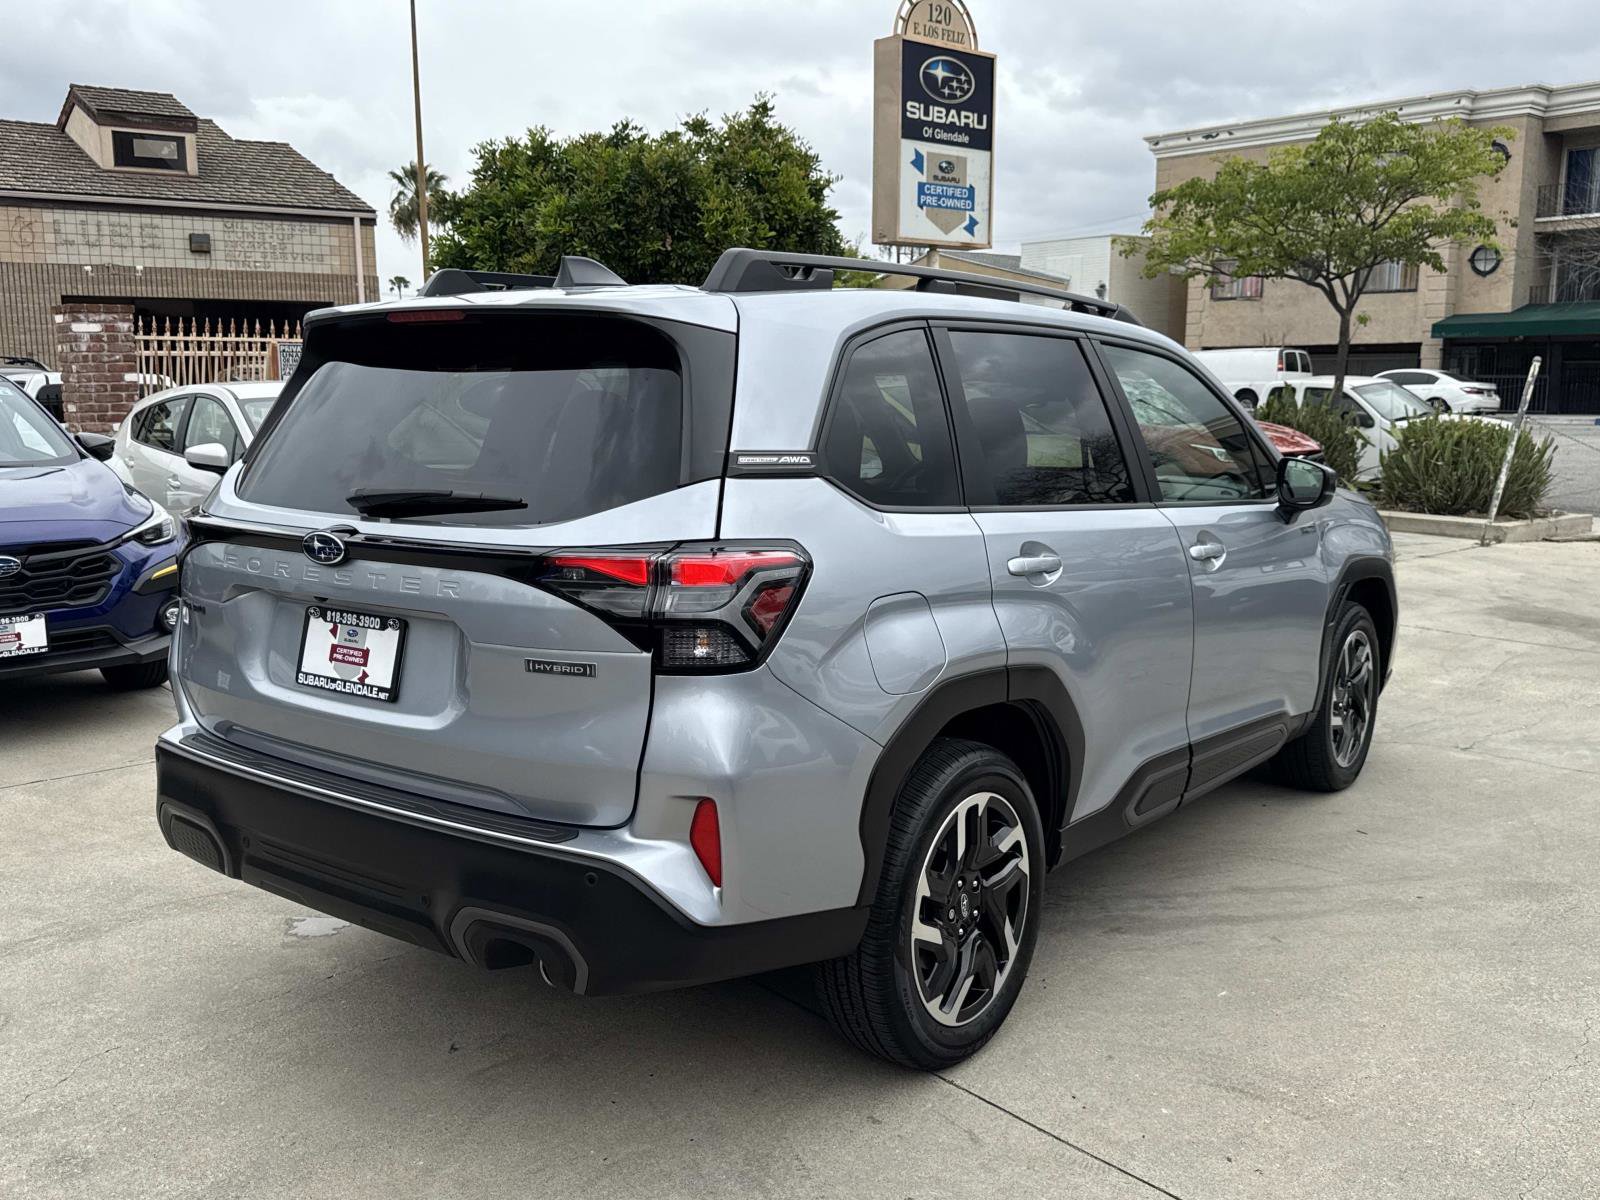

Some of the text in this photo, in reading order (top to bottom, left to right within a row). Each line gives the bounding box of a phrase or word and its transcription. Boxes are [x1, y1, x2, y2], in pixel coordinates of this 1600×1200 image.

[928, 3, 951, 26] 120
[913, 22, 965, 45] E. LOS FELIZ
[906, 101, 987, 129] SUBARU
[922, 127, 969, 144] Of Glendale
[933, 174, 960, 184] SUBARU
[924, 184, 968, 198] CERTIFIED
[920, 195, 972, 209] PRE-OWNED
[779, 455, 811, 464] AWD
[218, 552, 461, 600] FORESTER
[326, 610, 381, 629] 818-396-3900
[332, 653, 365, 665] PRE-OWNED
[336, 647, 363, 657] CERTIFIED
[535, 663, 584, 674] HYBRID
